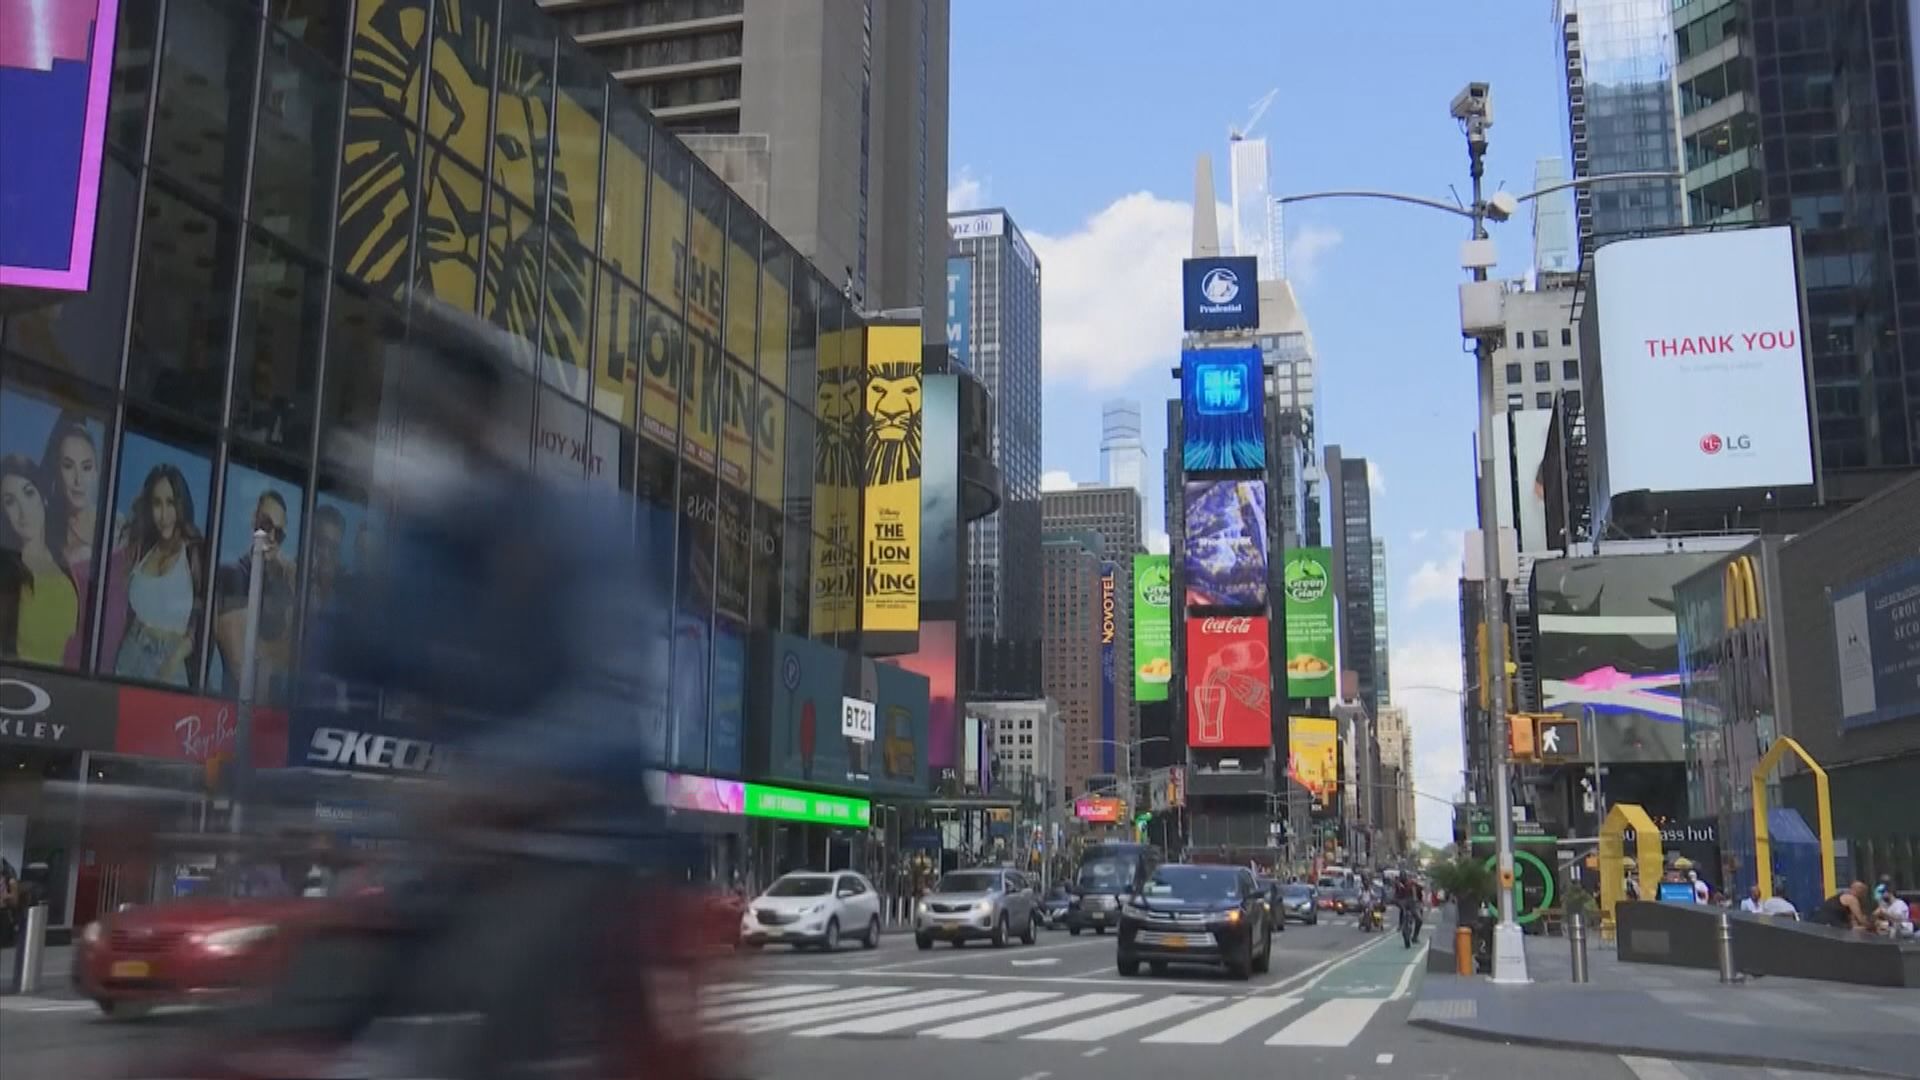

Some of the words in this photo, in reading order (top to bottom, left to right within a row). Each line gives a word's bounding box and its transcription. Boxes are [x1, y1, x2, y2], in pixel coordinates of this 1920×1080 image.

[672, 236, 721, 318] THE
[1199, 304, 1242, 314] Prudential
[1645, 334, 1734, 357] THANK
[1742, 330, 1795, 350] YOU
[1727, 434, 1751, 450] LG
[875, 523, 904, 537] THE
[869, 539, 910, 565] LION
[866, 566, 915, 596] KING
[1102, 571, 1115, 644] NOVOTEL
[846, 705, 872, 732] BT21
[1687, 826, 1715, 841] hut
